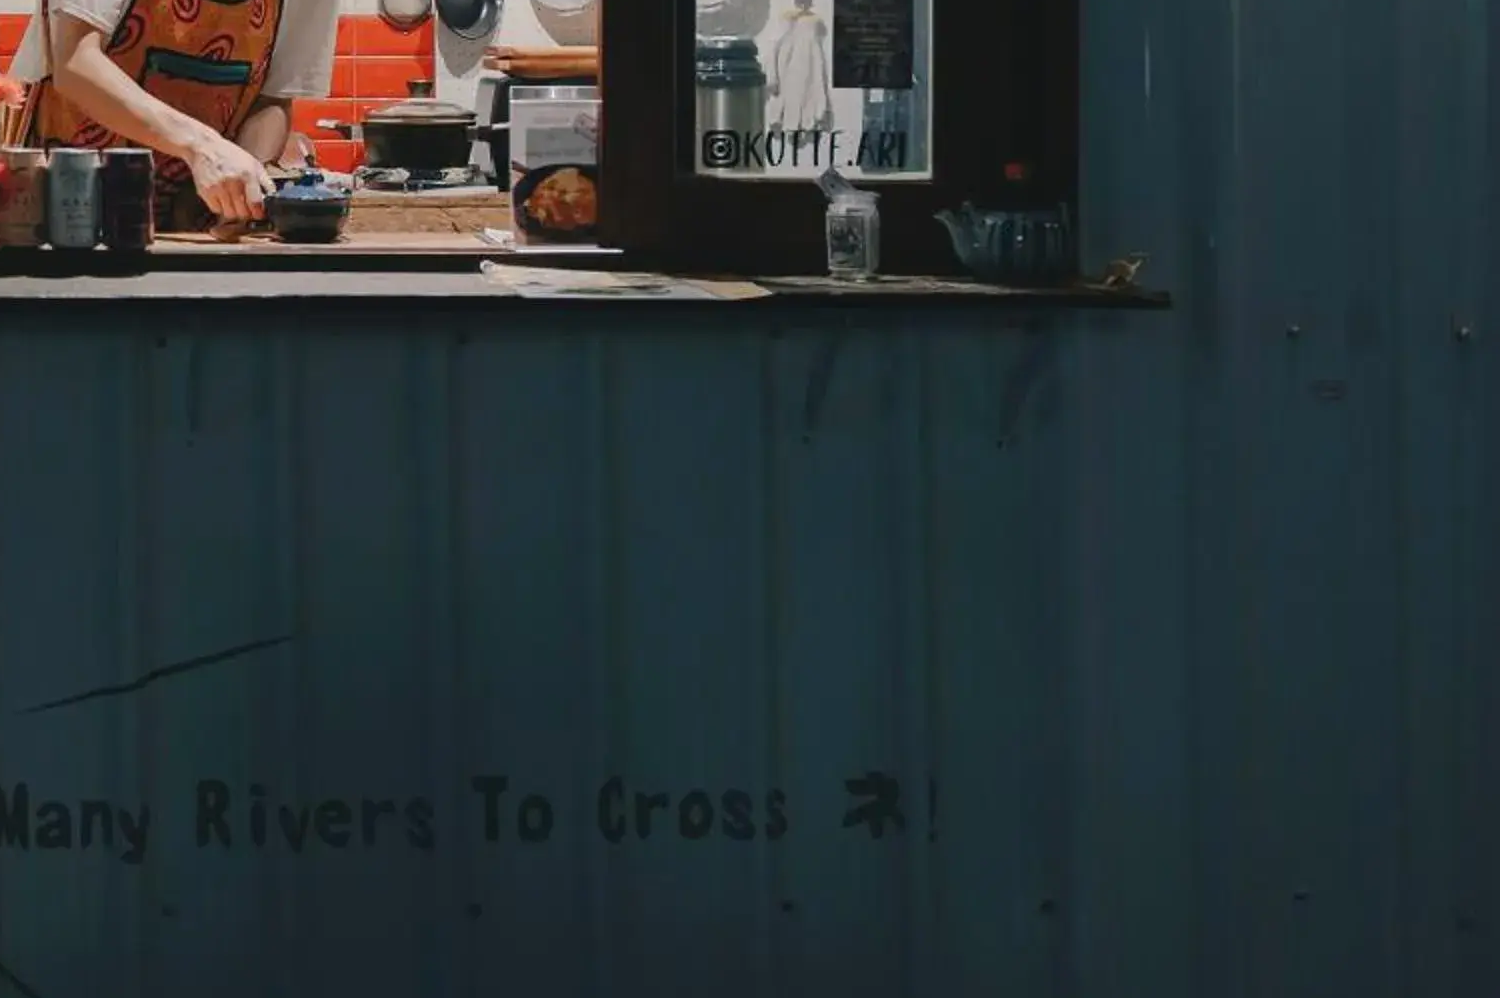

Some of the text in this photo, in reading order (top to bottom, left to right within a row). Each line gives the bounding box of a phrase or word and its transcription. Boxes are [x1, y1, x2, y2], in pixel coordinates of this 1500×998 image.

[195, 778, 437, 853] Rivers
[471, 775, 554, 843] To
[597, 775, 789, 844] Cross
